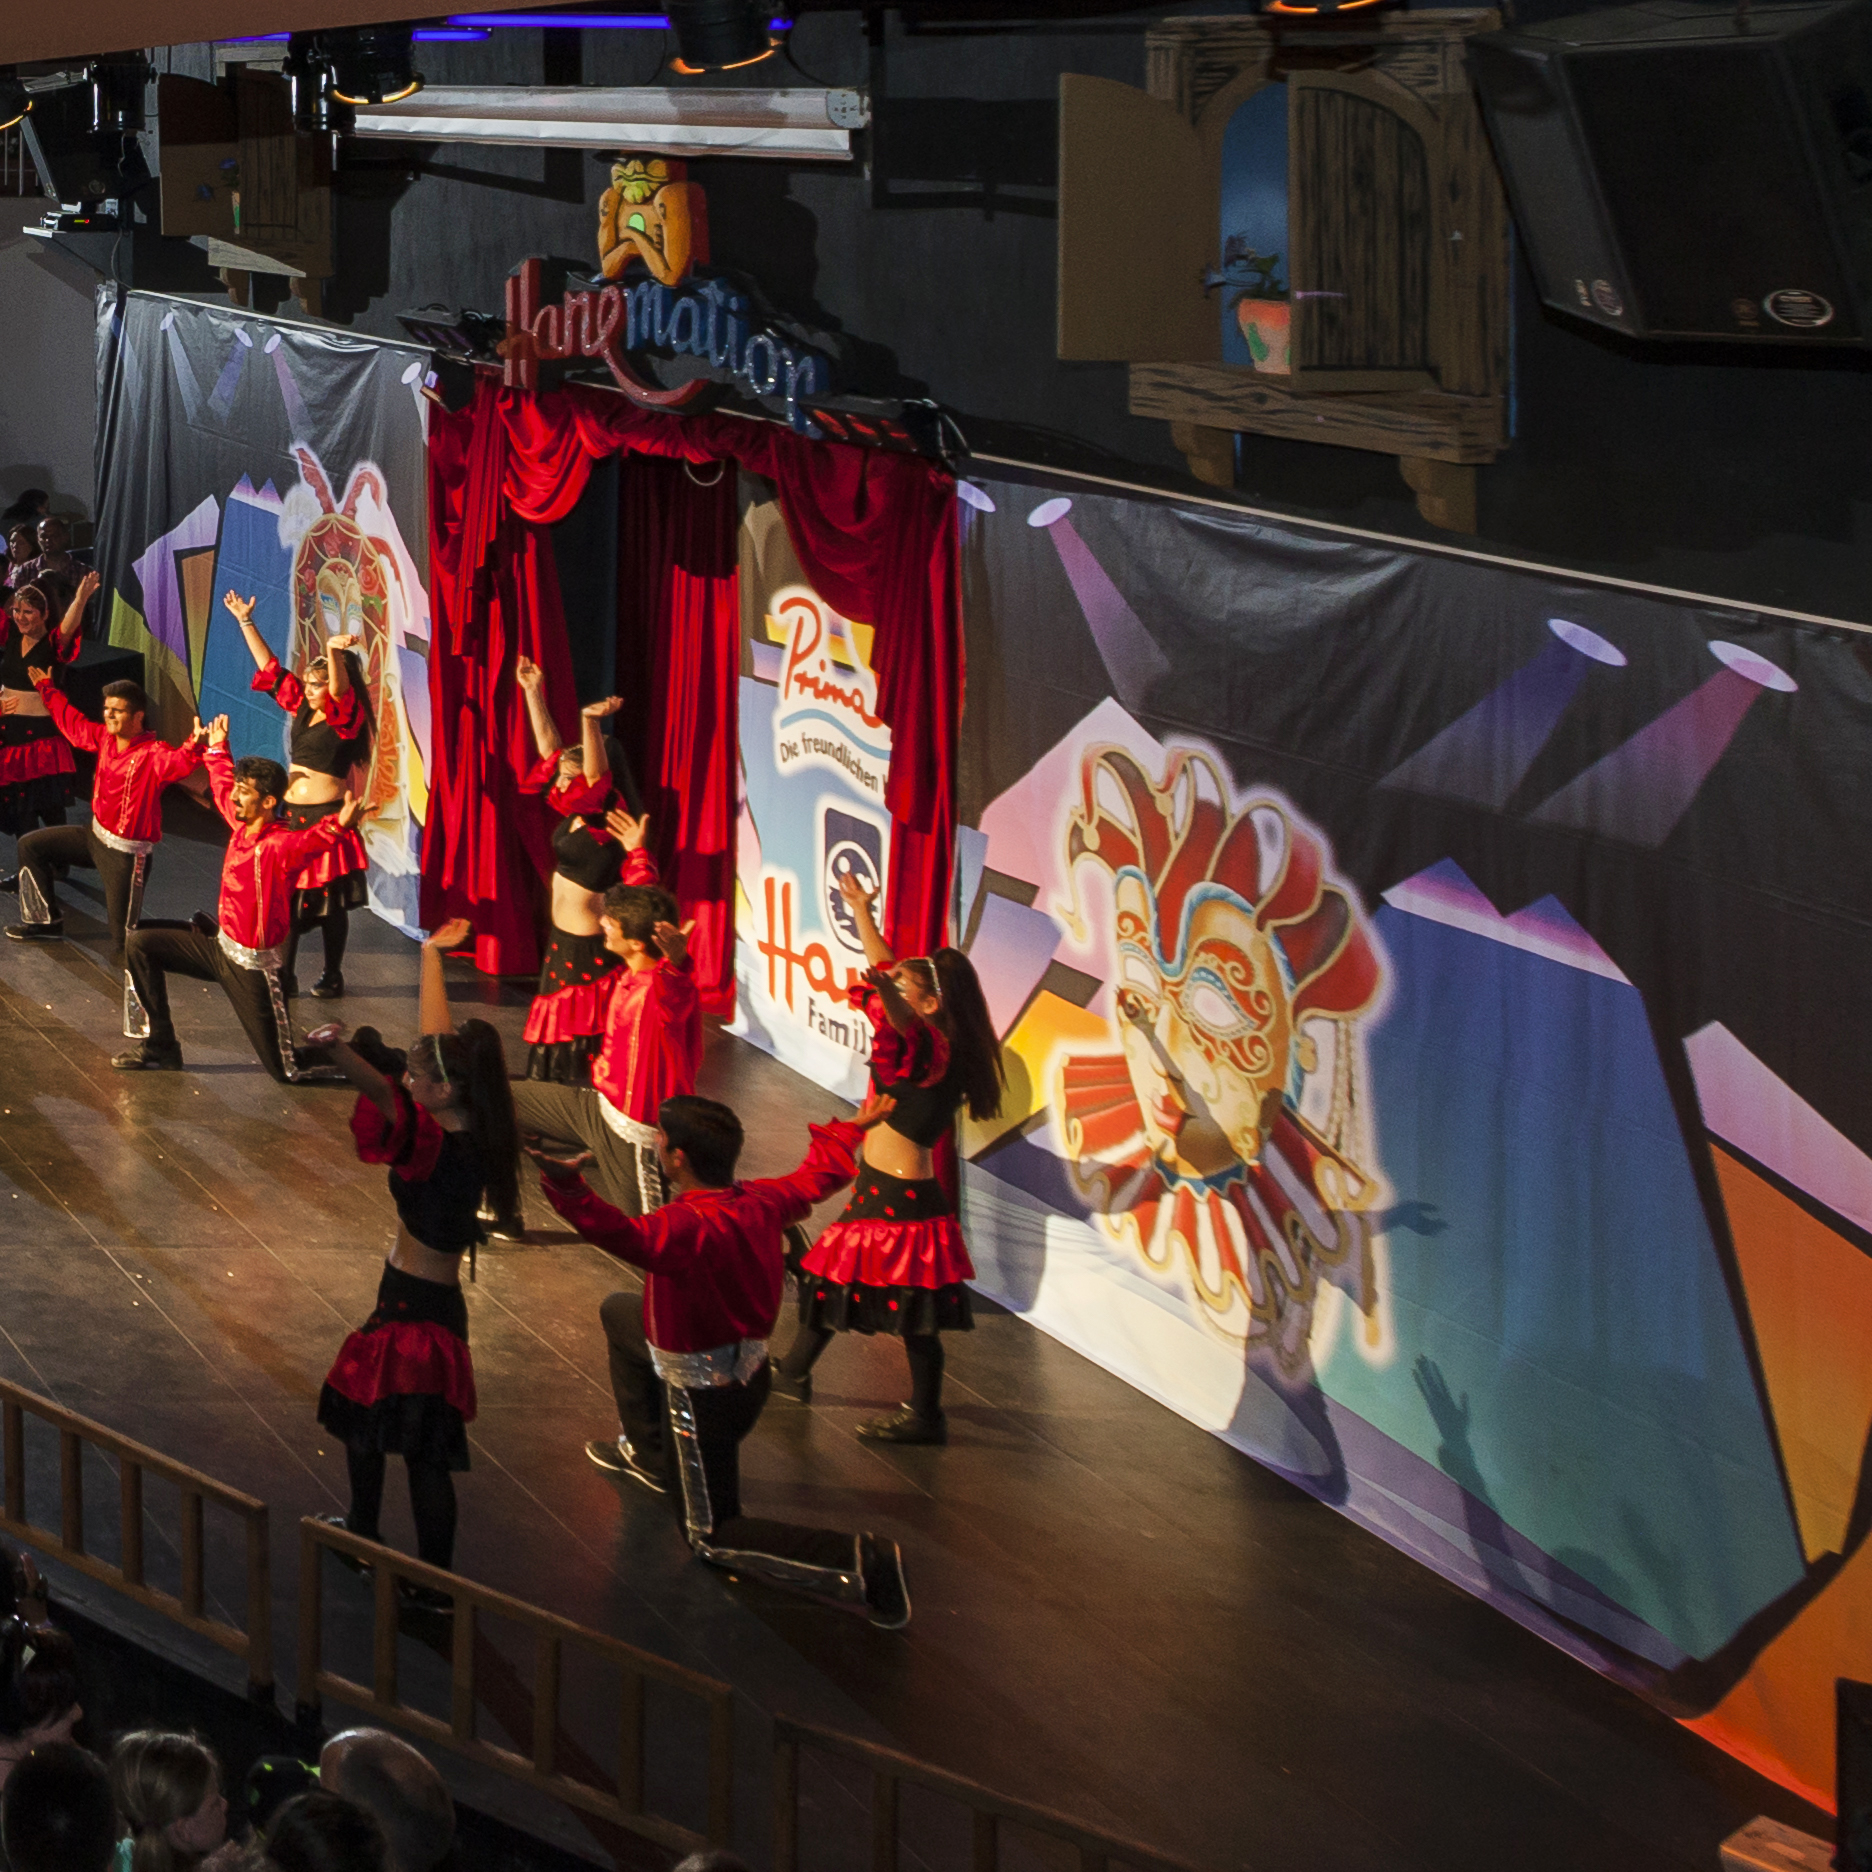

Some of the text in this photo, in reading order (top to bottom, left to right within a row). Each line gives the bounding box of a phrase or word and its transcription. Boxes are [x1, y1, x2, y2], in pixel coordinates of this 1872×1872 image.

[779, 596, 884, 729] Prima
[780, 740, 800, 764] Die
[802, 732, 879, 793] freundlichen
[808, 996, 874, 1066] Famil
